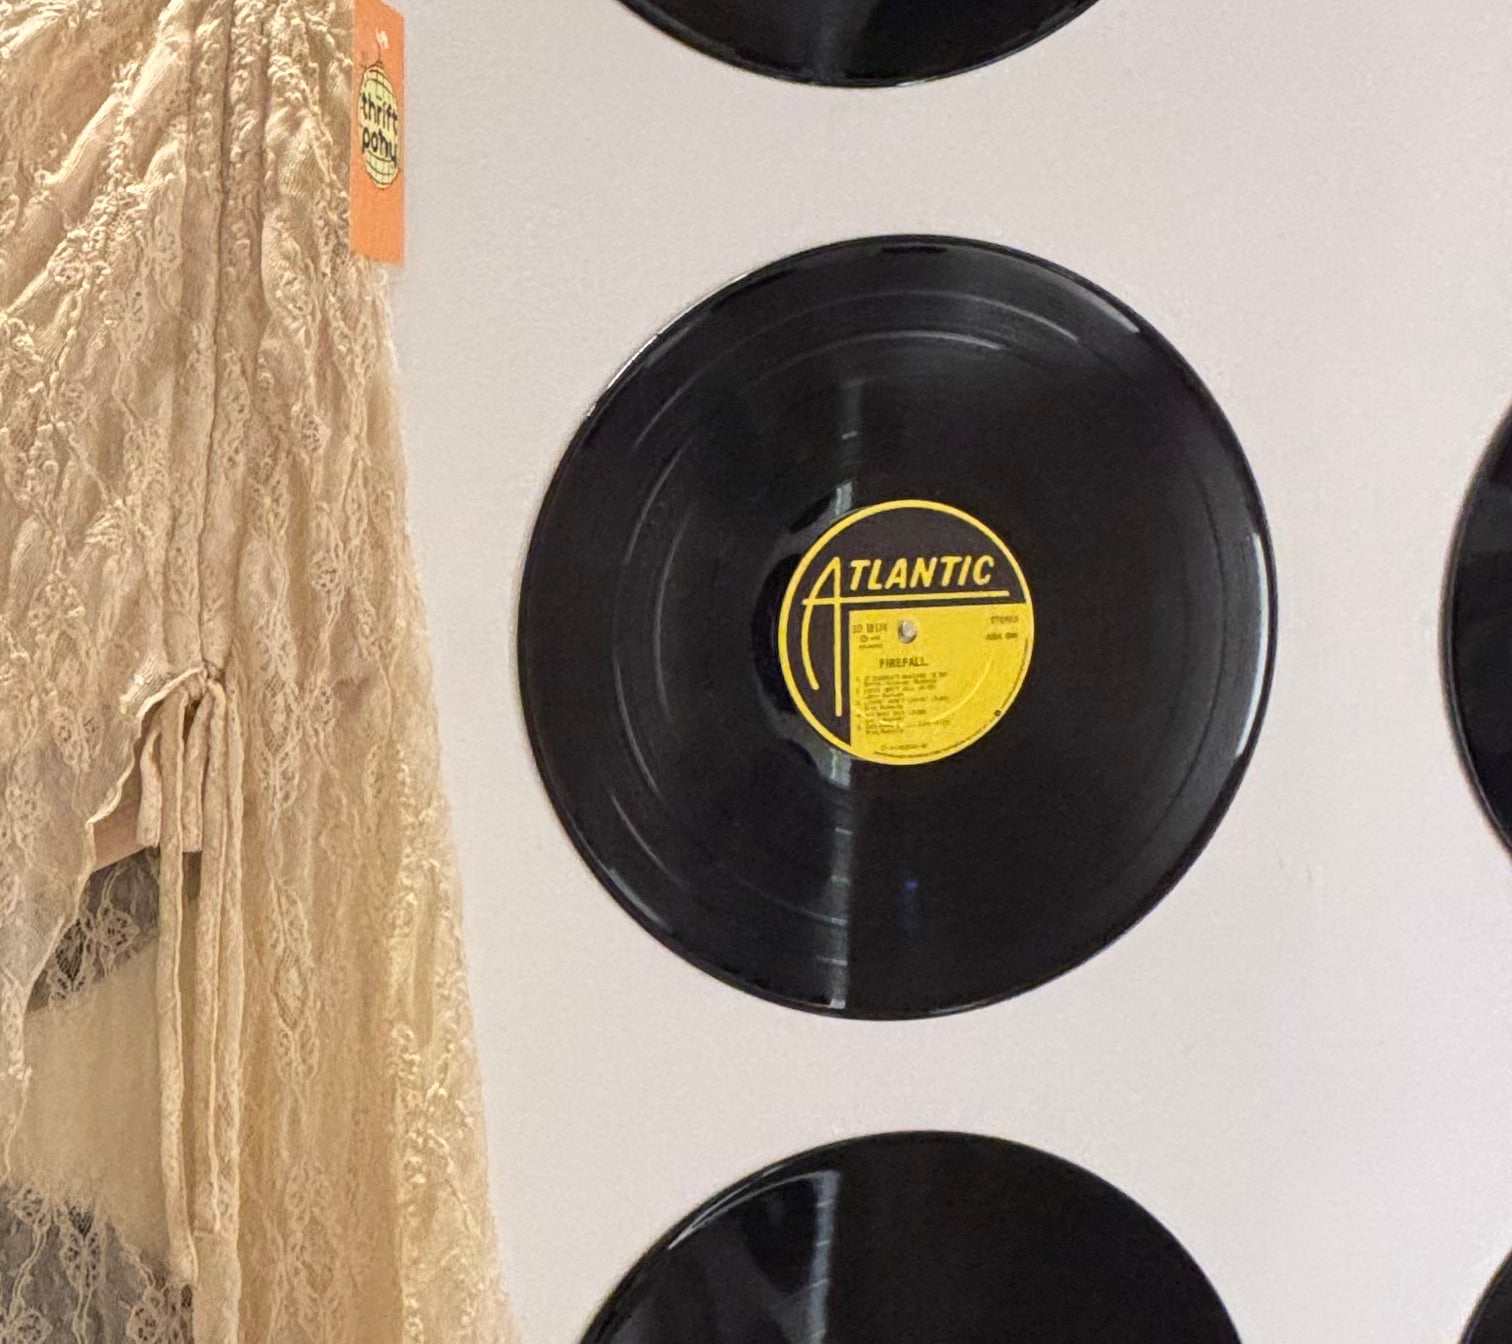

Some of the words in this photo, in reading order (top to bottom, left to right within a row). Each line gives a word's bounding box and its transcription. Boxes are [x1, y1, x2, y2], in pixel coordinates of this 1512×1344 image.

[360, 91, 398, 135] thrift
[361, 126, 398, 169] pony
[879, 657, 929, 669] FIREFALL
